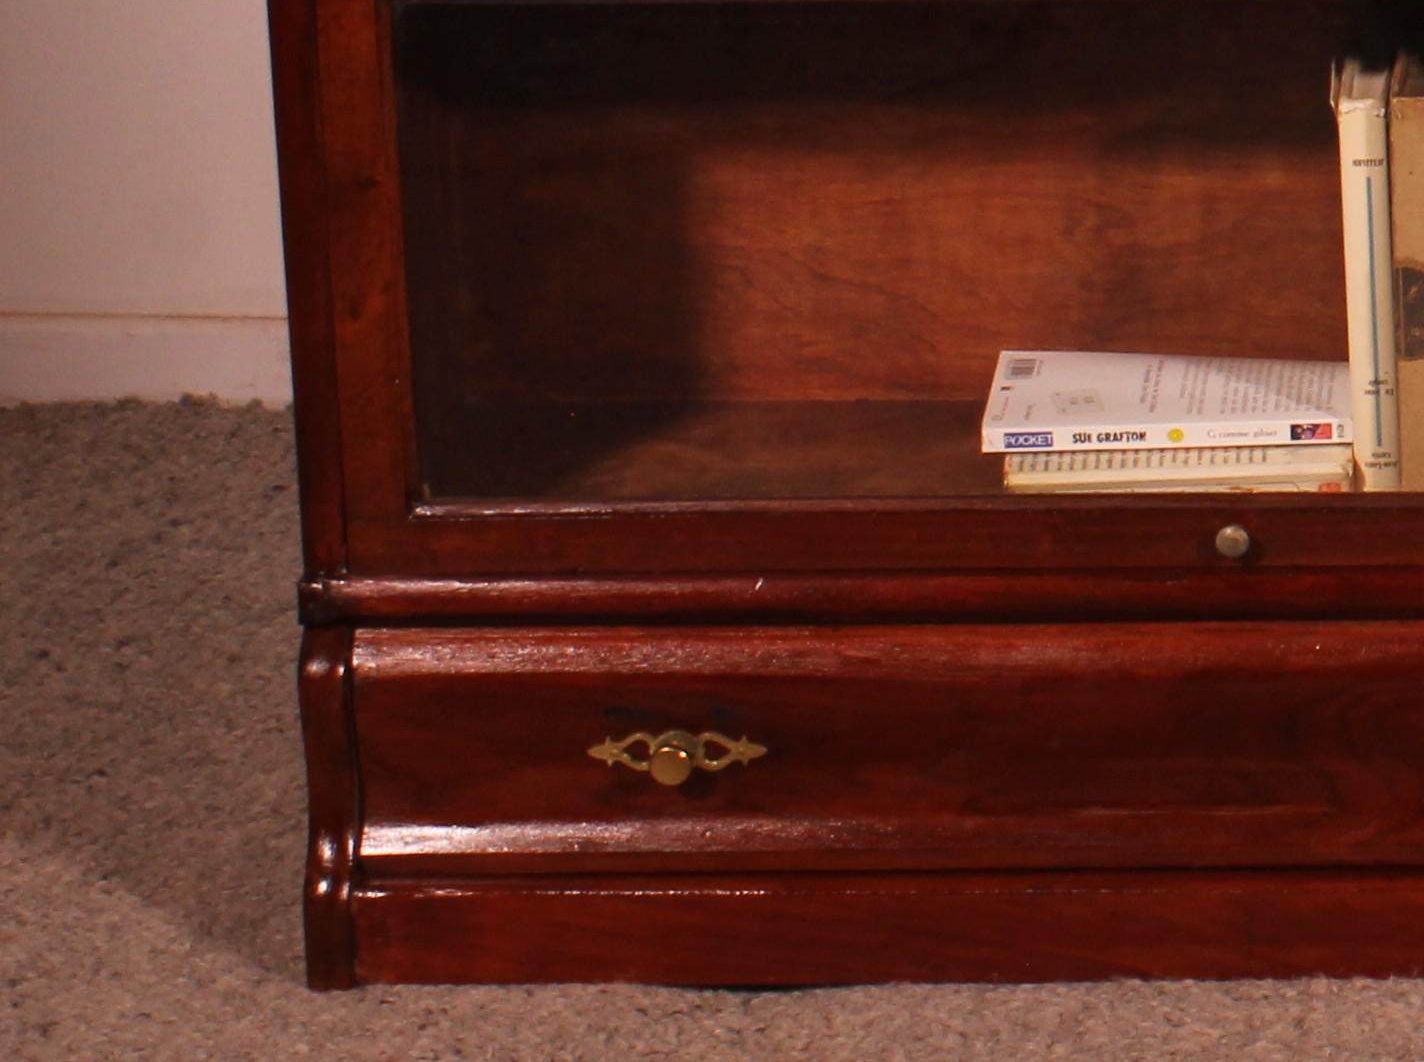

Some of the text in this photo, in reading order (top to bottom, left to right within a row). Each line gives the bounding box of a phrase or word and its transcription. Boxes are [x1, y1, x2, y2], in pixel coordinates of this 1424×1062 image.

[1003, 432, 1054, 447] POCKET
[1072, 430, 1148, 445] SUE GRAFTON
